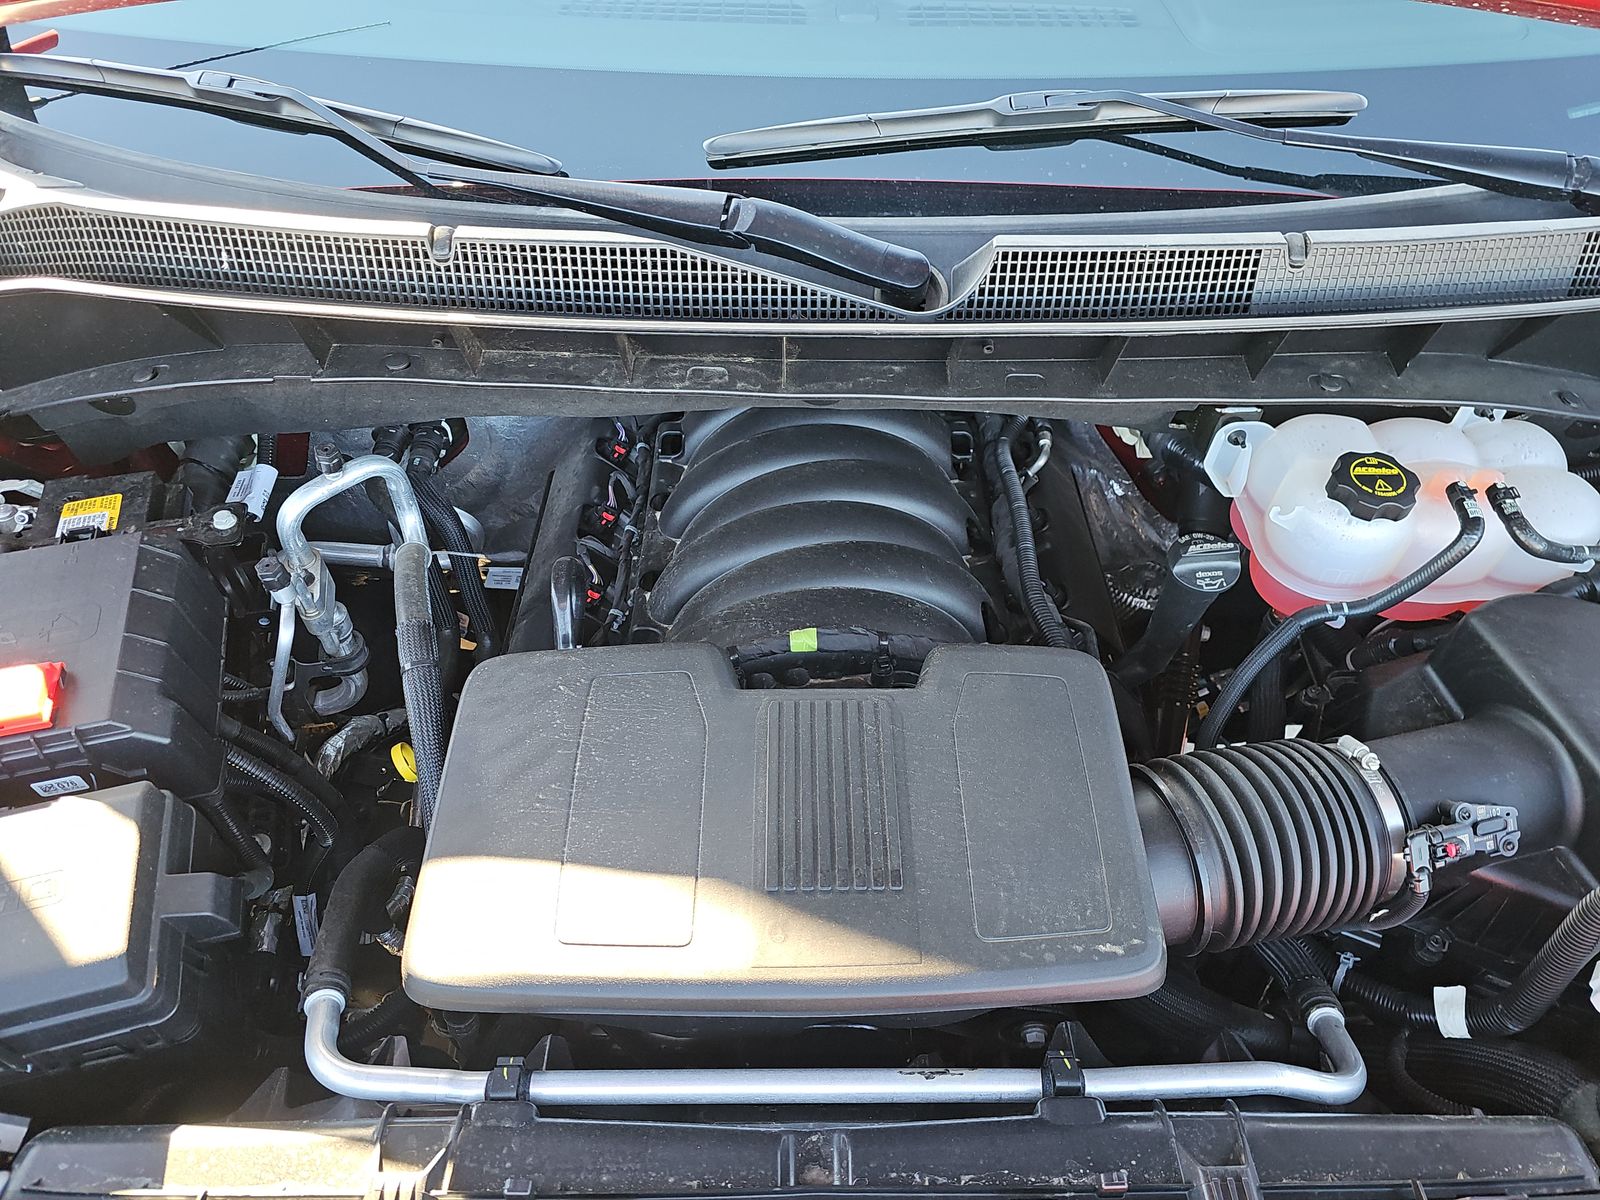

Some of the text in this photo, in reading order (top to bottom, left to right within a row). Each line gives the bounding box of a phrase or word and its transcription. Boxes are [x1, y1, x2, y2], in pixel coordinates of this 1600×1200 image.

[1353, 466, 1399, 475] ACDelco
[1178, 534, 1191, 544] SAE
[1188, 542, 1235, 552] ACDelco
[1196, 570, 1223, 578] dexos
